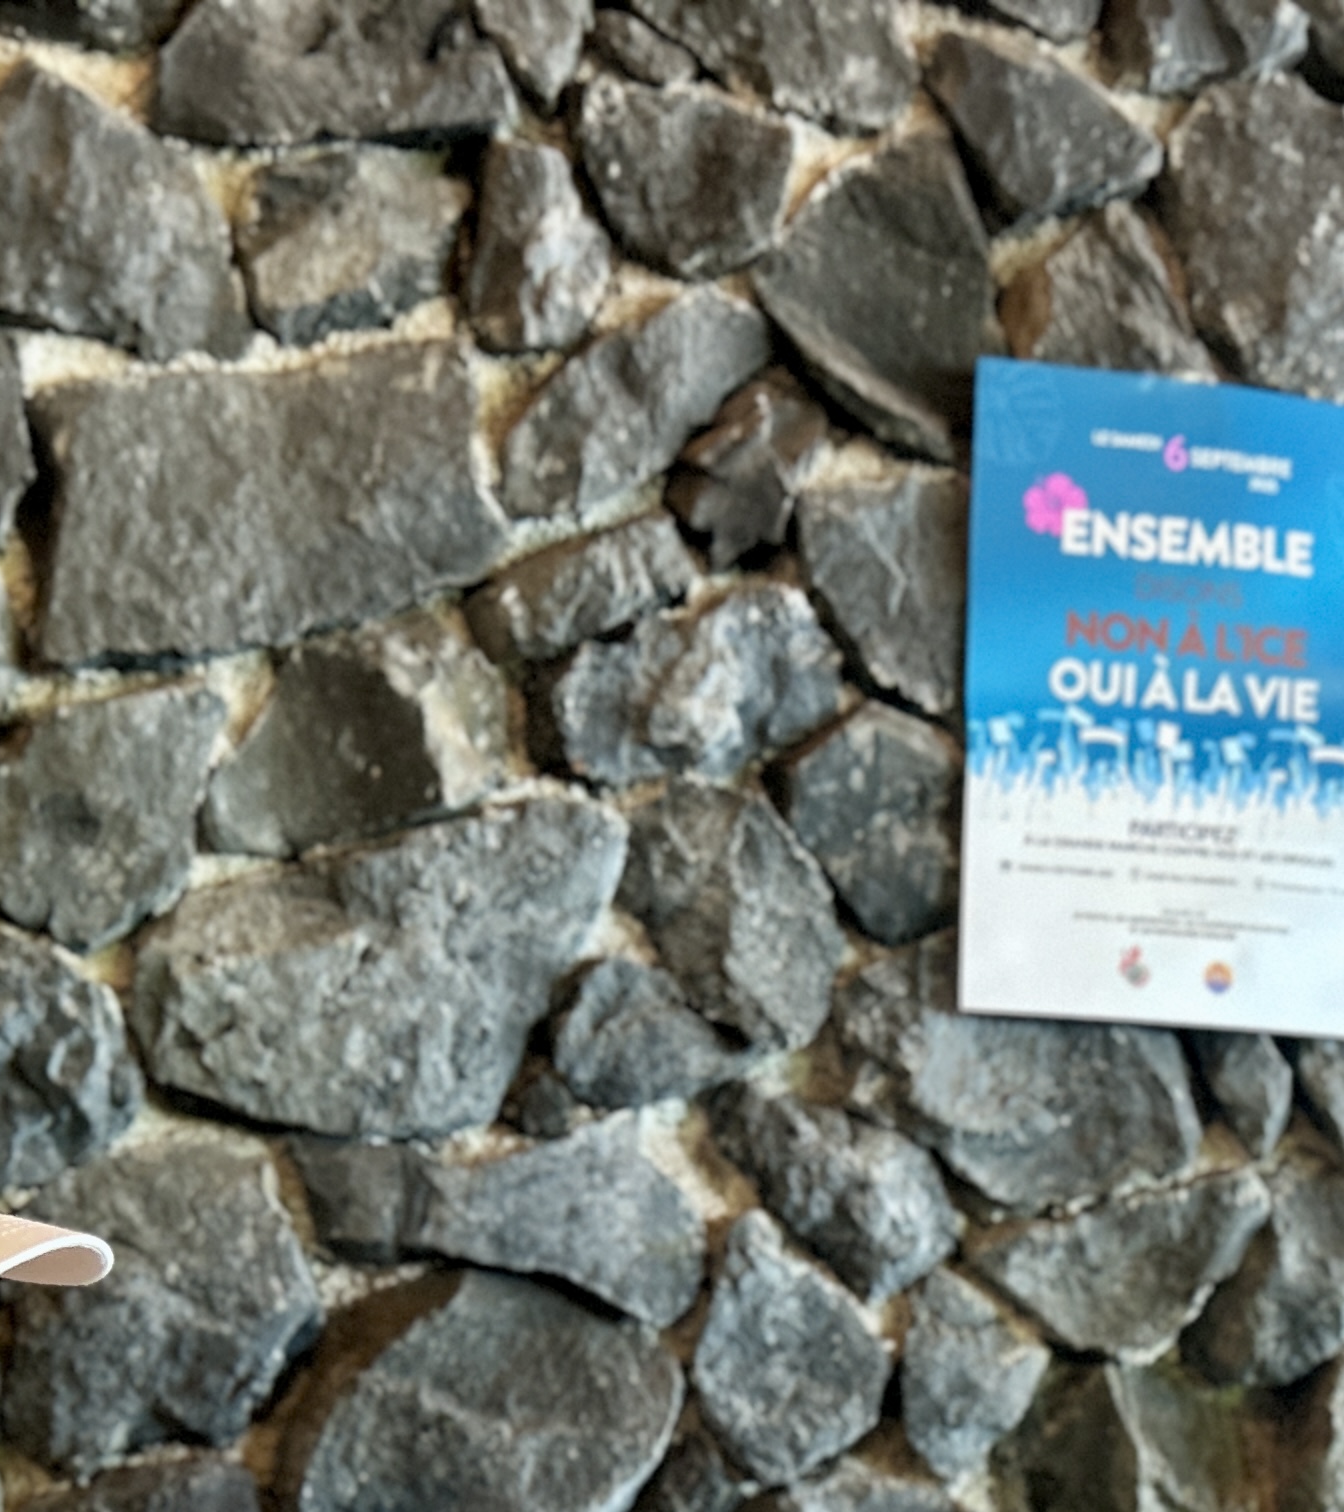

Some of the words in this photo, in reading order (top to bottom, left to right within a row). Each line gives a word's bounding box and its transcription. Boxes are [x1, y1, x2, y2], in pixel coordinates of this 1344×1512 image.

[1163, 434, 1190, 473] 6
[1189, 446, 1293, 480] SEPTEMBRE
[1059, 508, 1315, 578] ENSEMBLE
[1065, 610, 1169, 655] NON
[1176, 609, 1206, 658] À
[1216, 622, 1308, 669] L'ICE
[1048, 656, 1137, 708] OUI
[1141, 652, 1179, 711] À
[1184, 668, 1243, 718] LA
[1243, 672, 1320, 723] VIE
